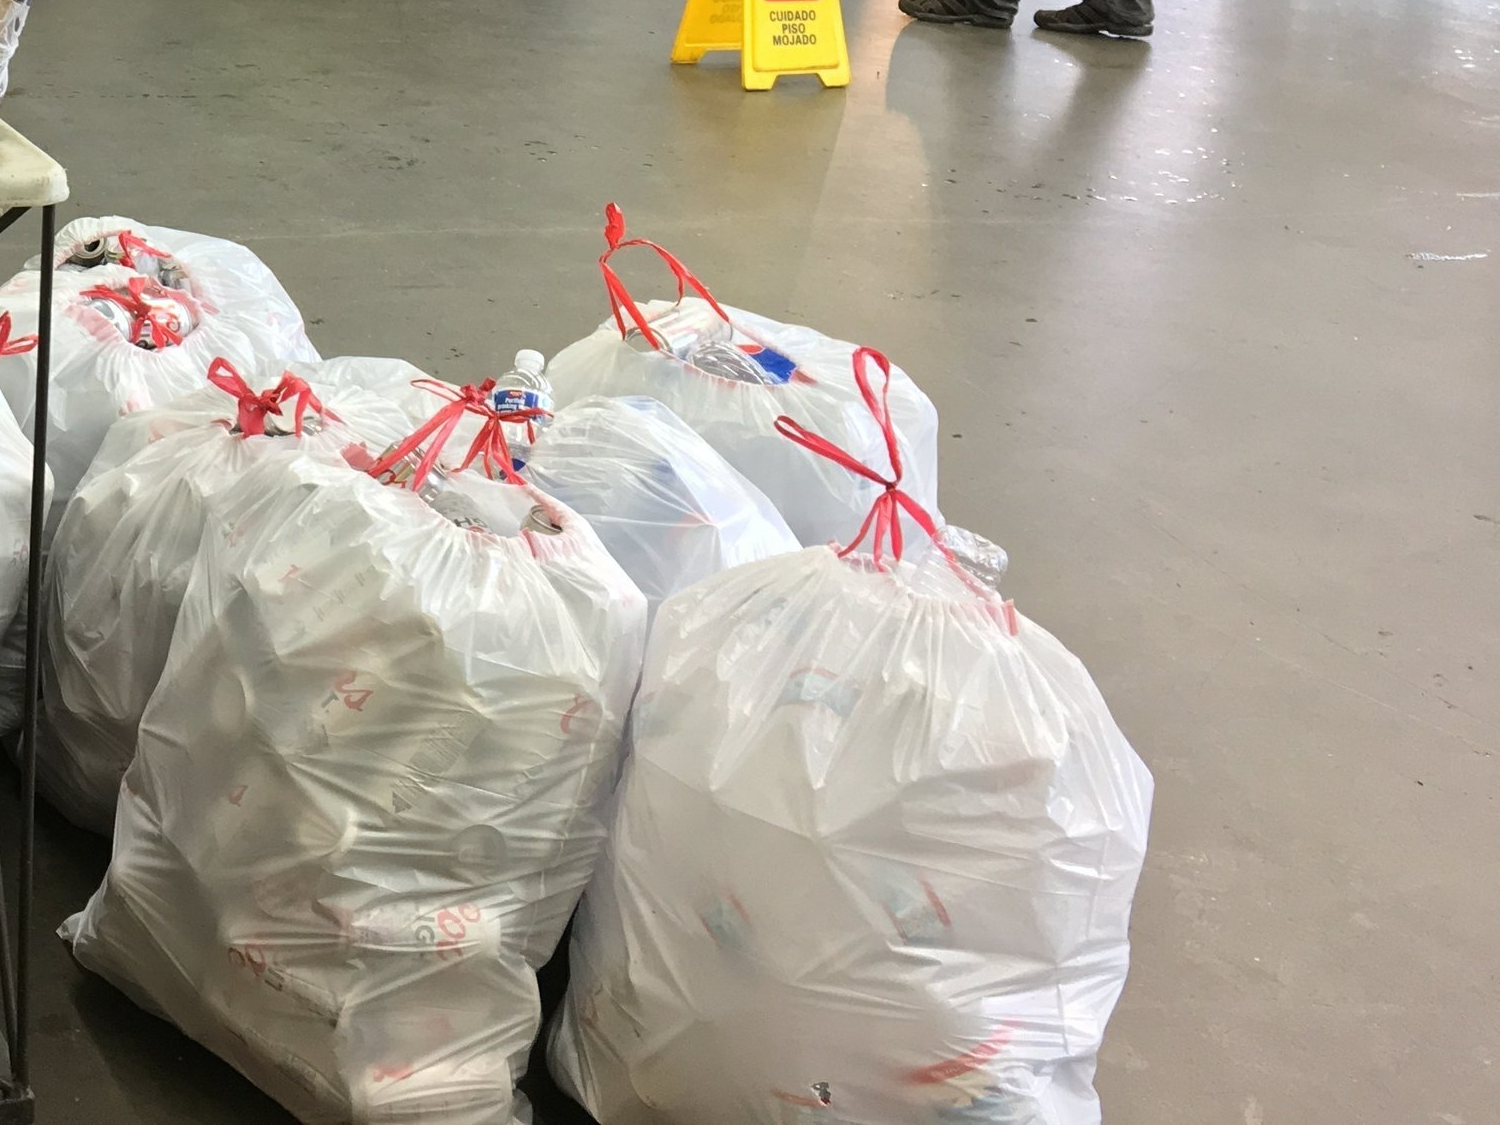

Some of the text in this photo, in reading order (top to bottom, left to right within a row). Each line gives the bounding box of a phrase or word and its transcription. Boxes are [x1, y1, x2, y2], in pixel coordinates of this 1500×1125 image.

[769, 10, 816, 22] CUIDADO
[781, 23, 806, 35] PISO
[772, 34, 817, 46] MOJADO
